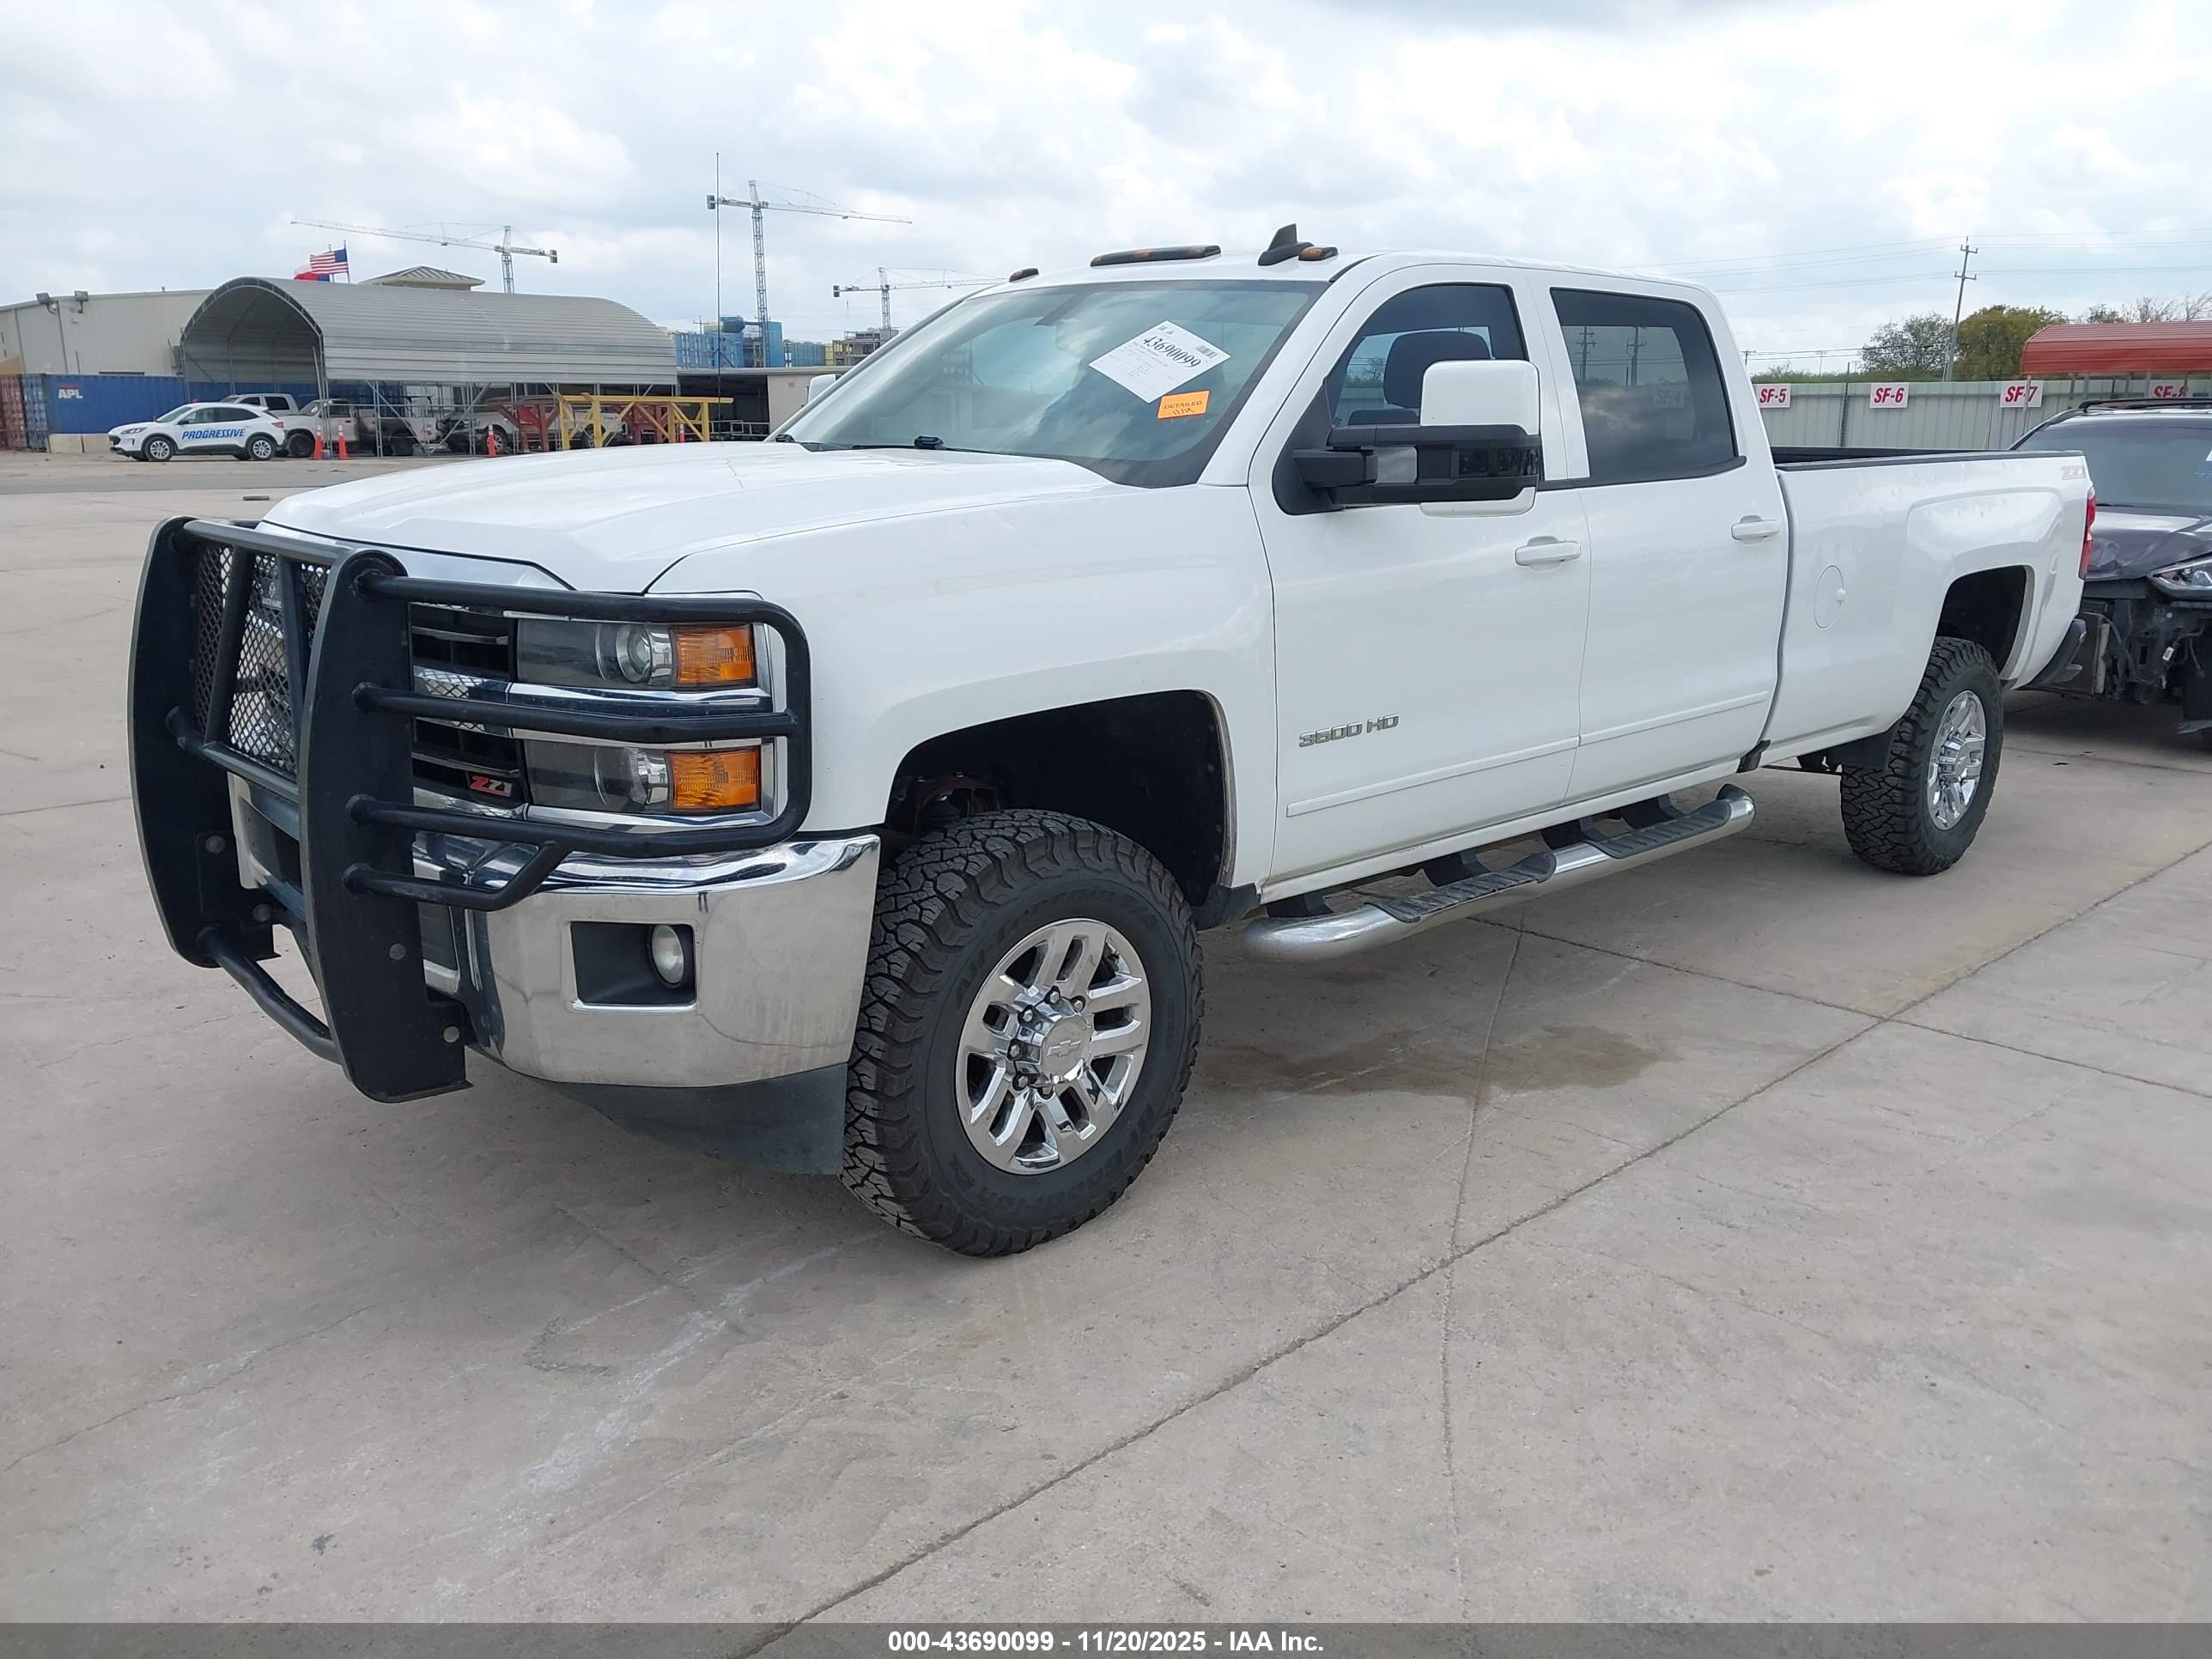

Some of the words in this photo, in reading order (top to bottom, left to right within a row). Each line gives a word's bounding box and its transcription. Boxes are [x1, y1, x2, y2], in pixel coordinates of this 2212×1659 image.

[1143, 336, 1202, 368] 43690099
[58, 388, 83, 399] APL
[1759, 388, 1787, 403] SF-5
[1874, 387, 1905, 403] SF-6
[1164, 400, 1202, 409] DETAILED
[182, 428, 246, 440] PROGRESSIVE
[1298, 721, 1363, 748] 3500
[1366, 714, 1399, 733] HD
[471, 775, 513, 797] Z71
